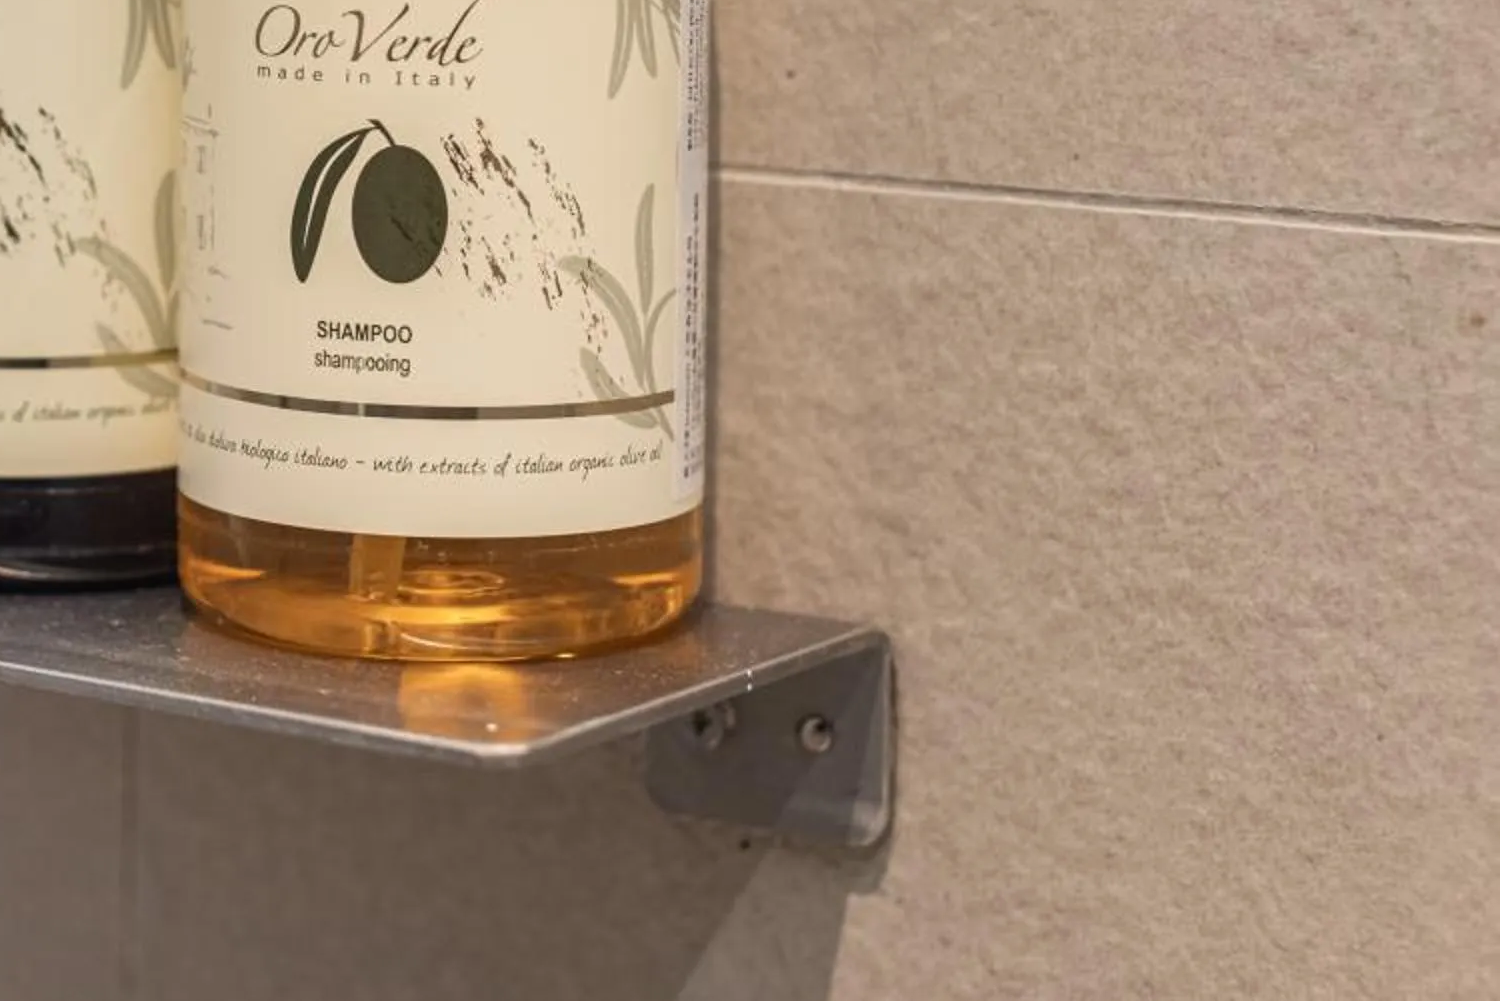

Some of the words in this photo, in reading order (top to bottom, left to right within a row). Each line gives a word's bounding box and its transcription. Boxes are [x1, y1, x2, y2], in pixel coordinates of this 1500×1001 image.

[256, 65, 323, 82] made
[345, 69, 371, 83] in
[396, 71, 476, 90] Italy
[316, 320, 413, 344] SHAMPOO
[314, 350, 411, 377] shampooing
[373, 456, 413, 474] with
[419, 455, 487, 475] extracts
[493, 452, 512, 477] of
[515, 452, 564, 475] italian
